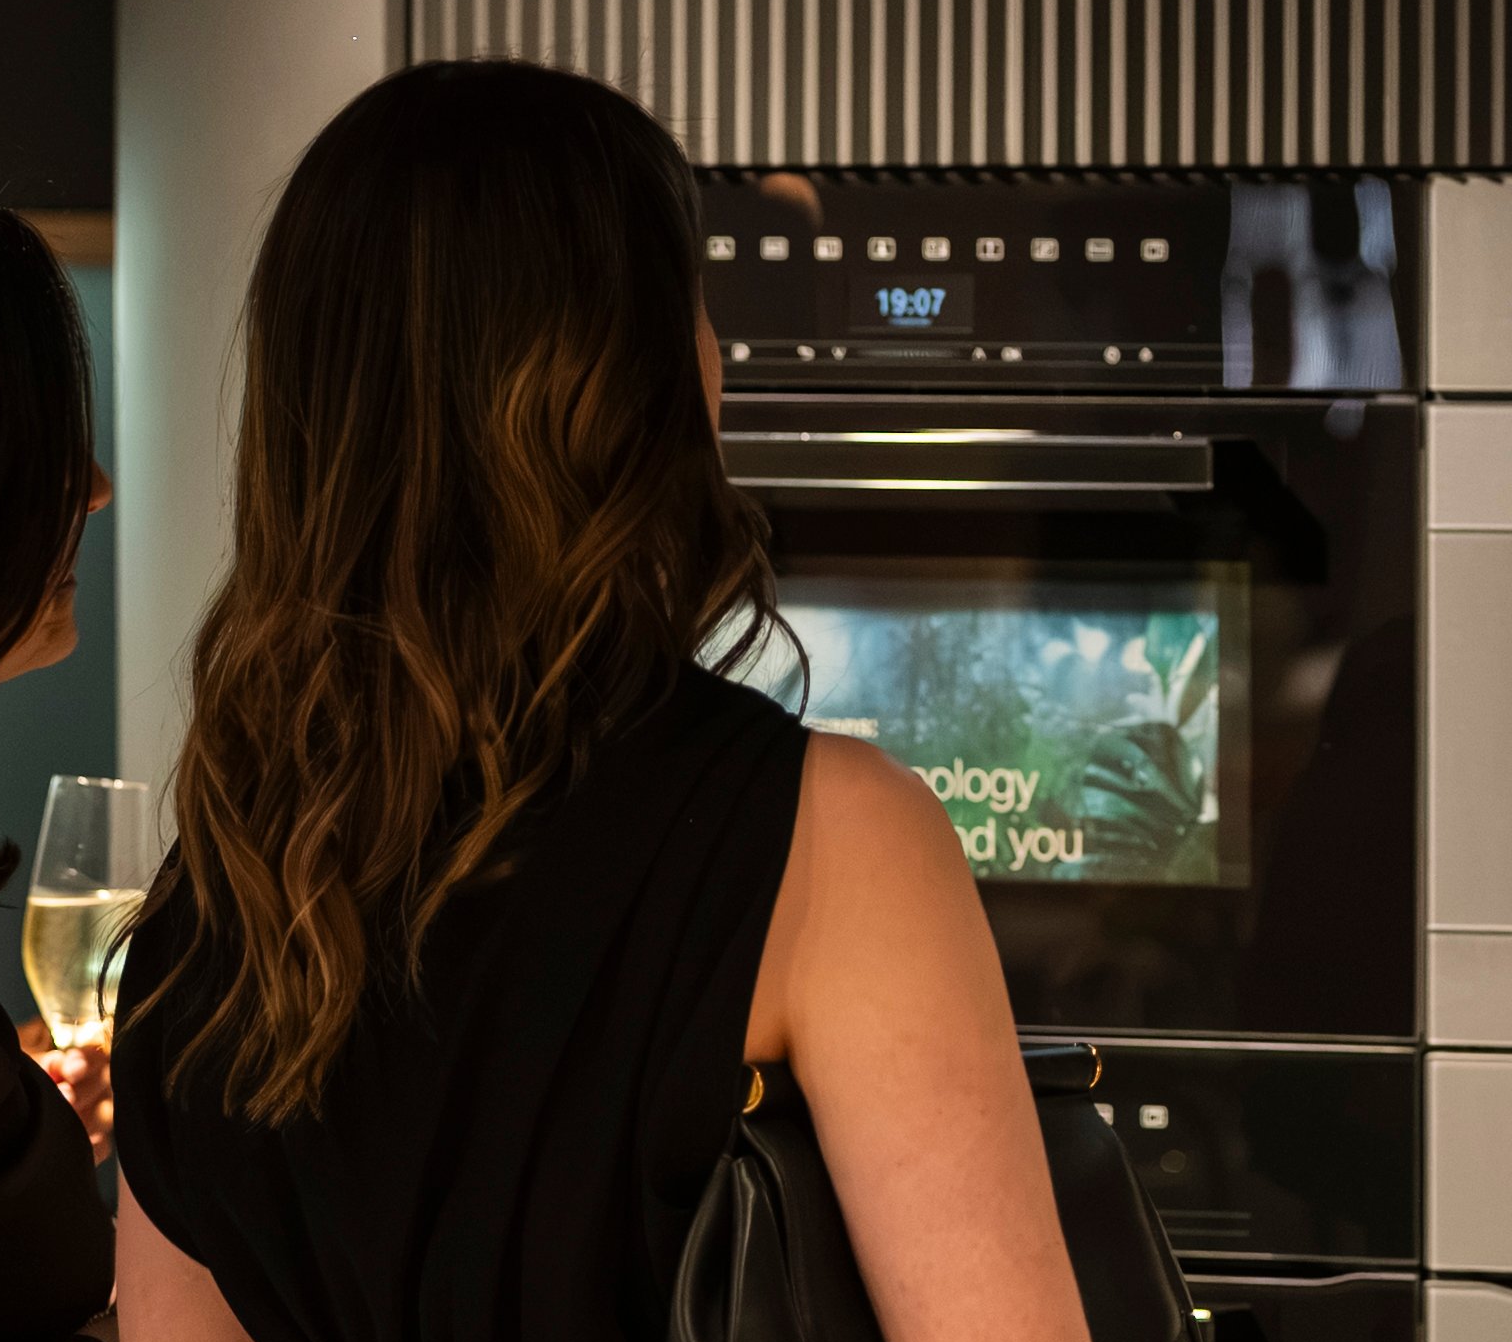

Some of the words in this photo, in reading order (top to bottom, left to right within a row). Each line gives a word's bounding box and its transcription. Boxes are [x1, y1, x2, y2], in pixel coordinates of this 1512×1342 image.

[875, 287, 946, 317] 19:07
[910, 757, 1040, 812] ology
[1007, 826, 1083, 872] you
